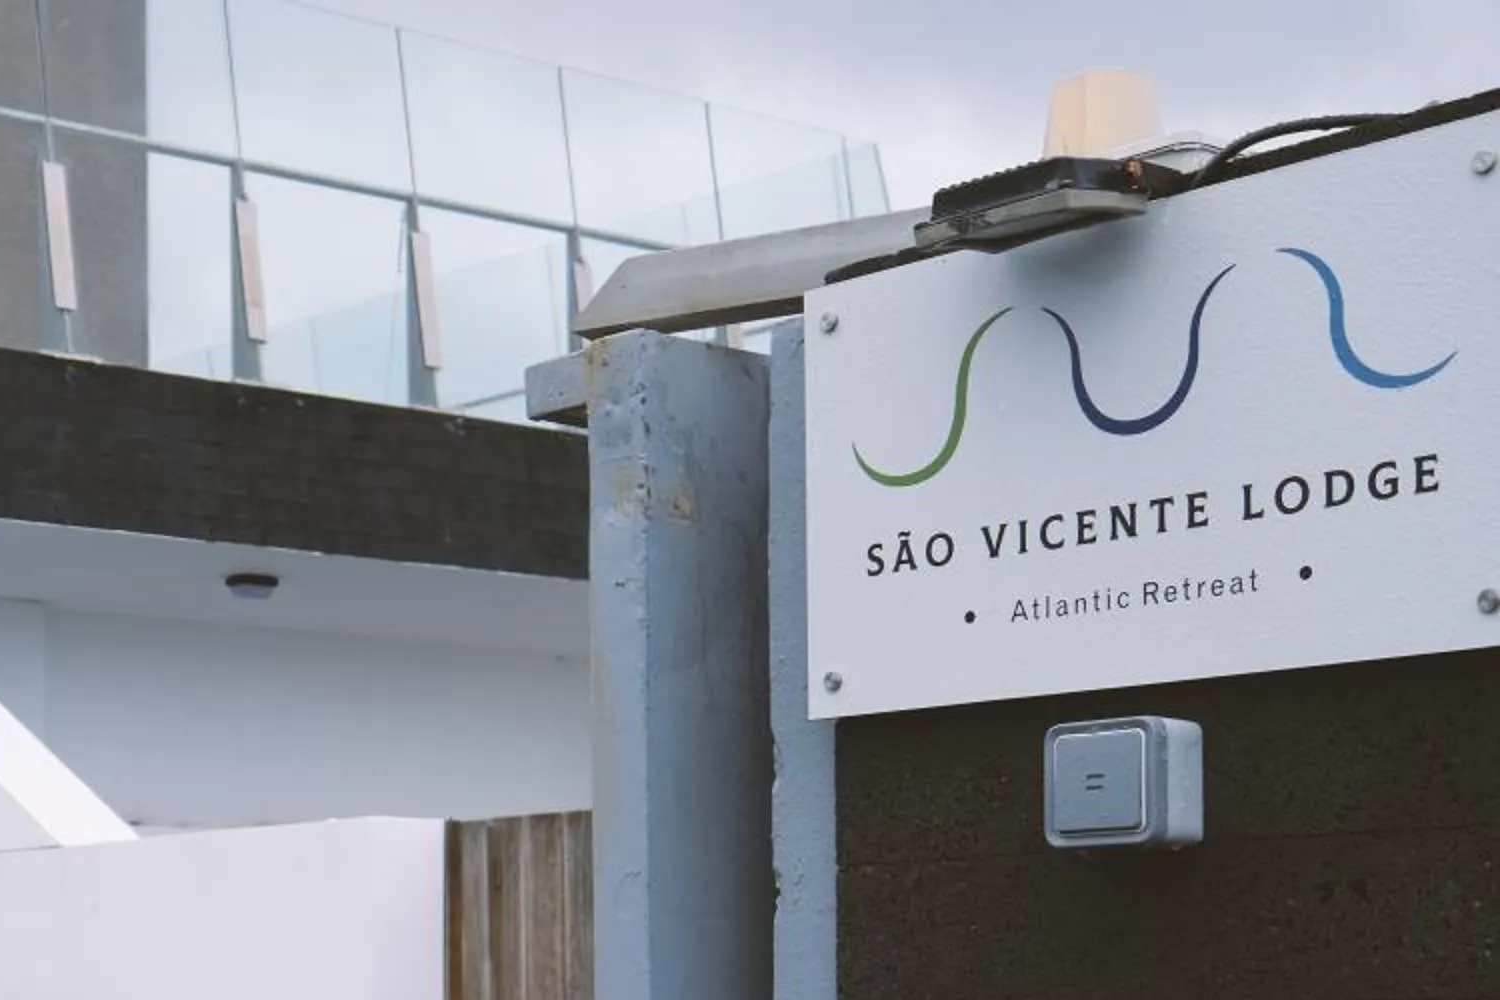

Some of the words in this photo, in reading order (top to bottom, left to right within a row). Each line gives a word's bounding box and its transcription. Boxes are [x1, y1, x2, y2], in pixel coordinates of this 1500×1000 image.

[866, 530, 955, 577] SÃO
[980, 490, 1210, 559] VICENTE
[1241, 453, 1441, 521] LODGE
[1010, 590, 1130, 623] Atlantic
[1142, 568, 1260, 607] Retreat
